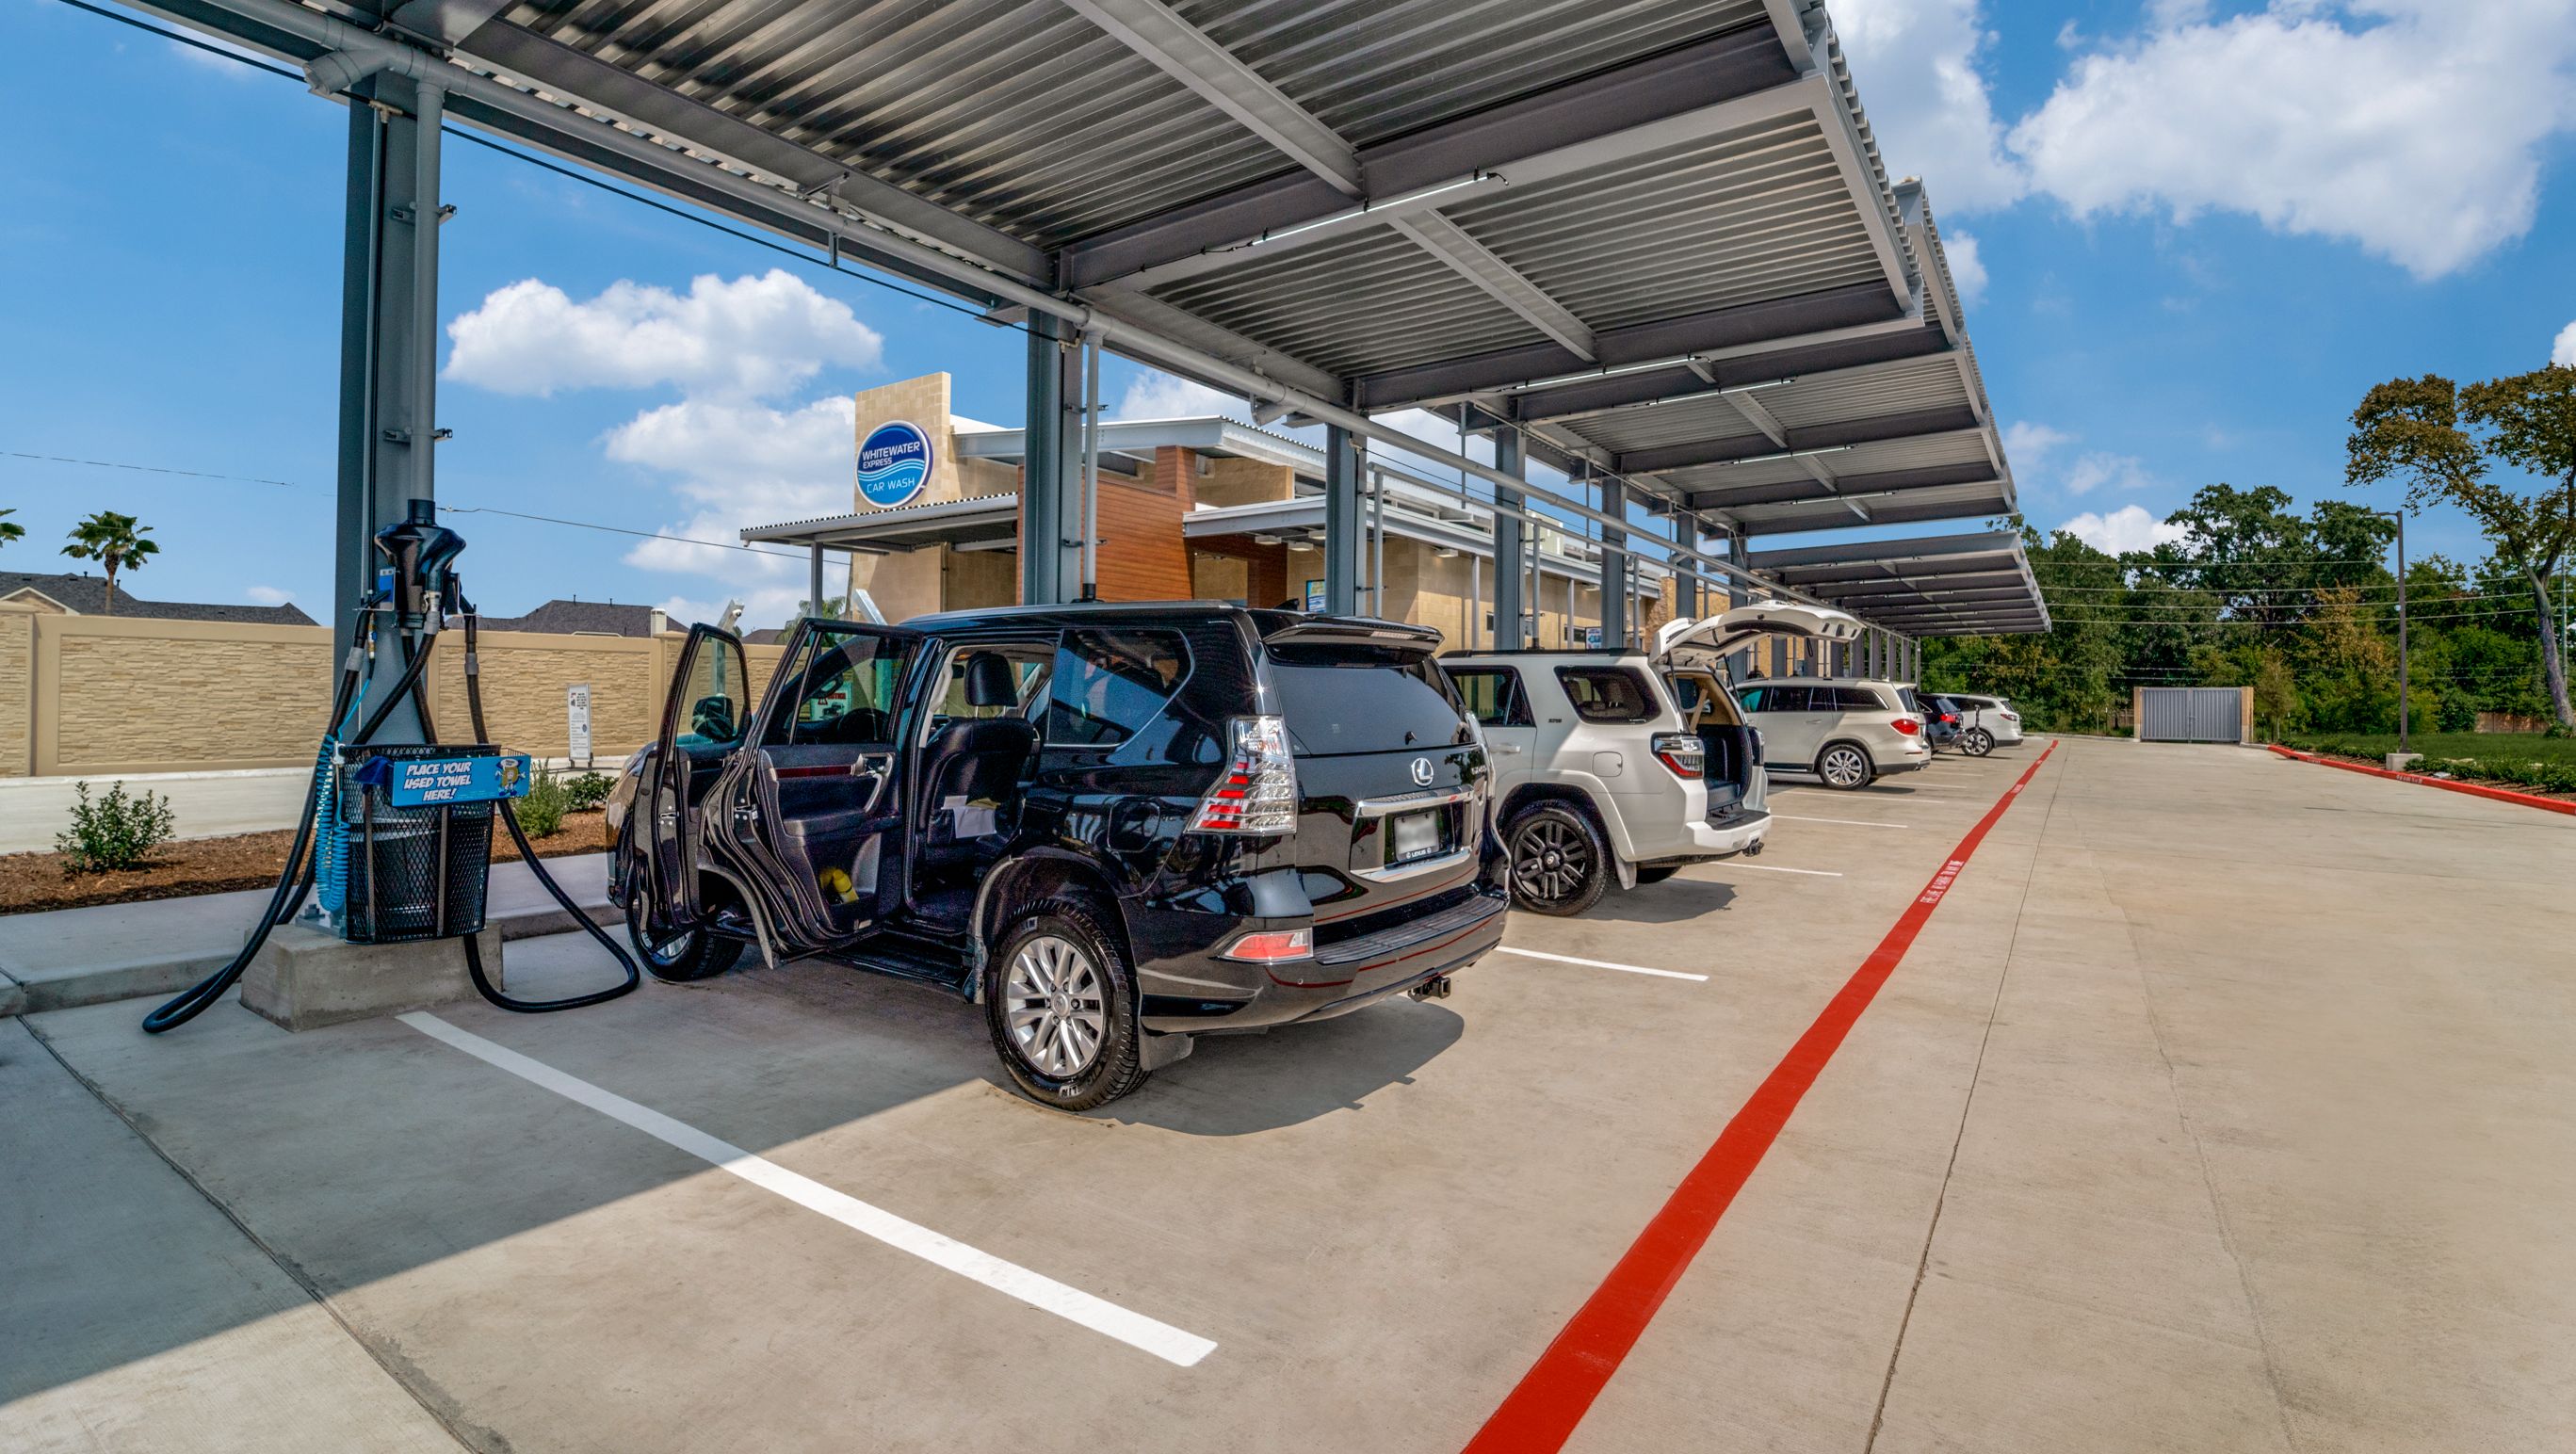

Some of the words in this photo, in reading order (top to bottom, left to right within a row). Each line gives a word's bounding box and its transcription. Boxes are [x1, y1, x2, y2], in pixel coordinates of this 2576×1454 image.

[862, 441, 920, 460] WHITEWATER
[863, 457, 892, 469] EXPRESS
[867, 481, 884, 493] CAR
[887, 477, 915, 491] WASH
[406, 763, 440, 776] PLACE
[442, 761, 472, 773] YOUR
[403, 777, 434, 789] USED
[437, 775, 472, 787] TOWEL
[423, 788, 458, 801] HERE!
